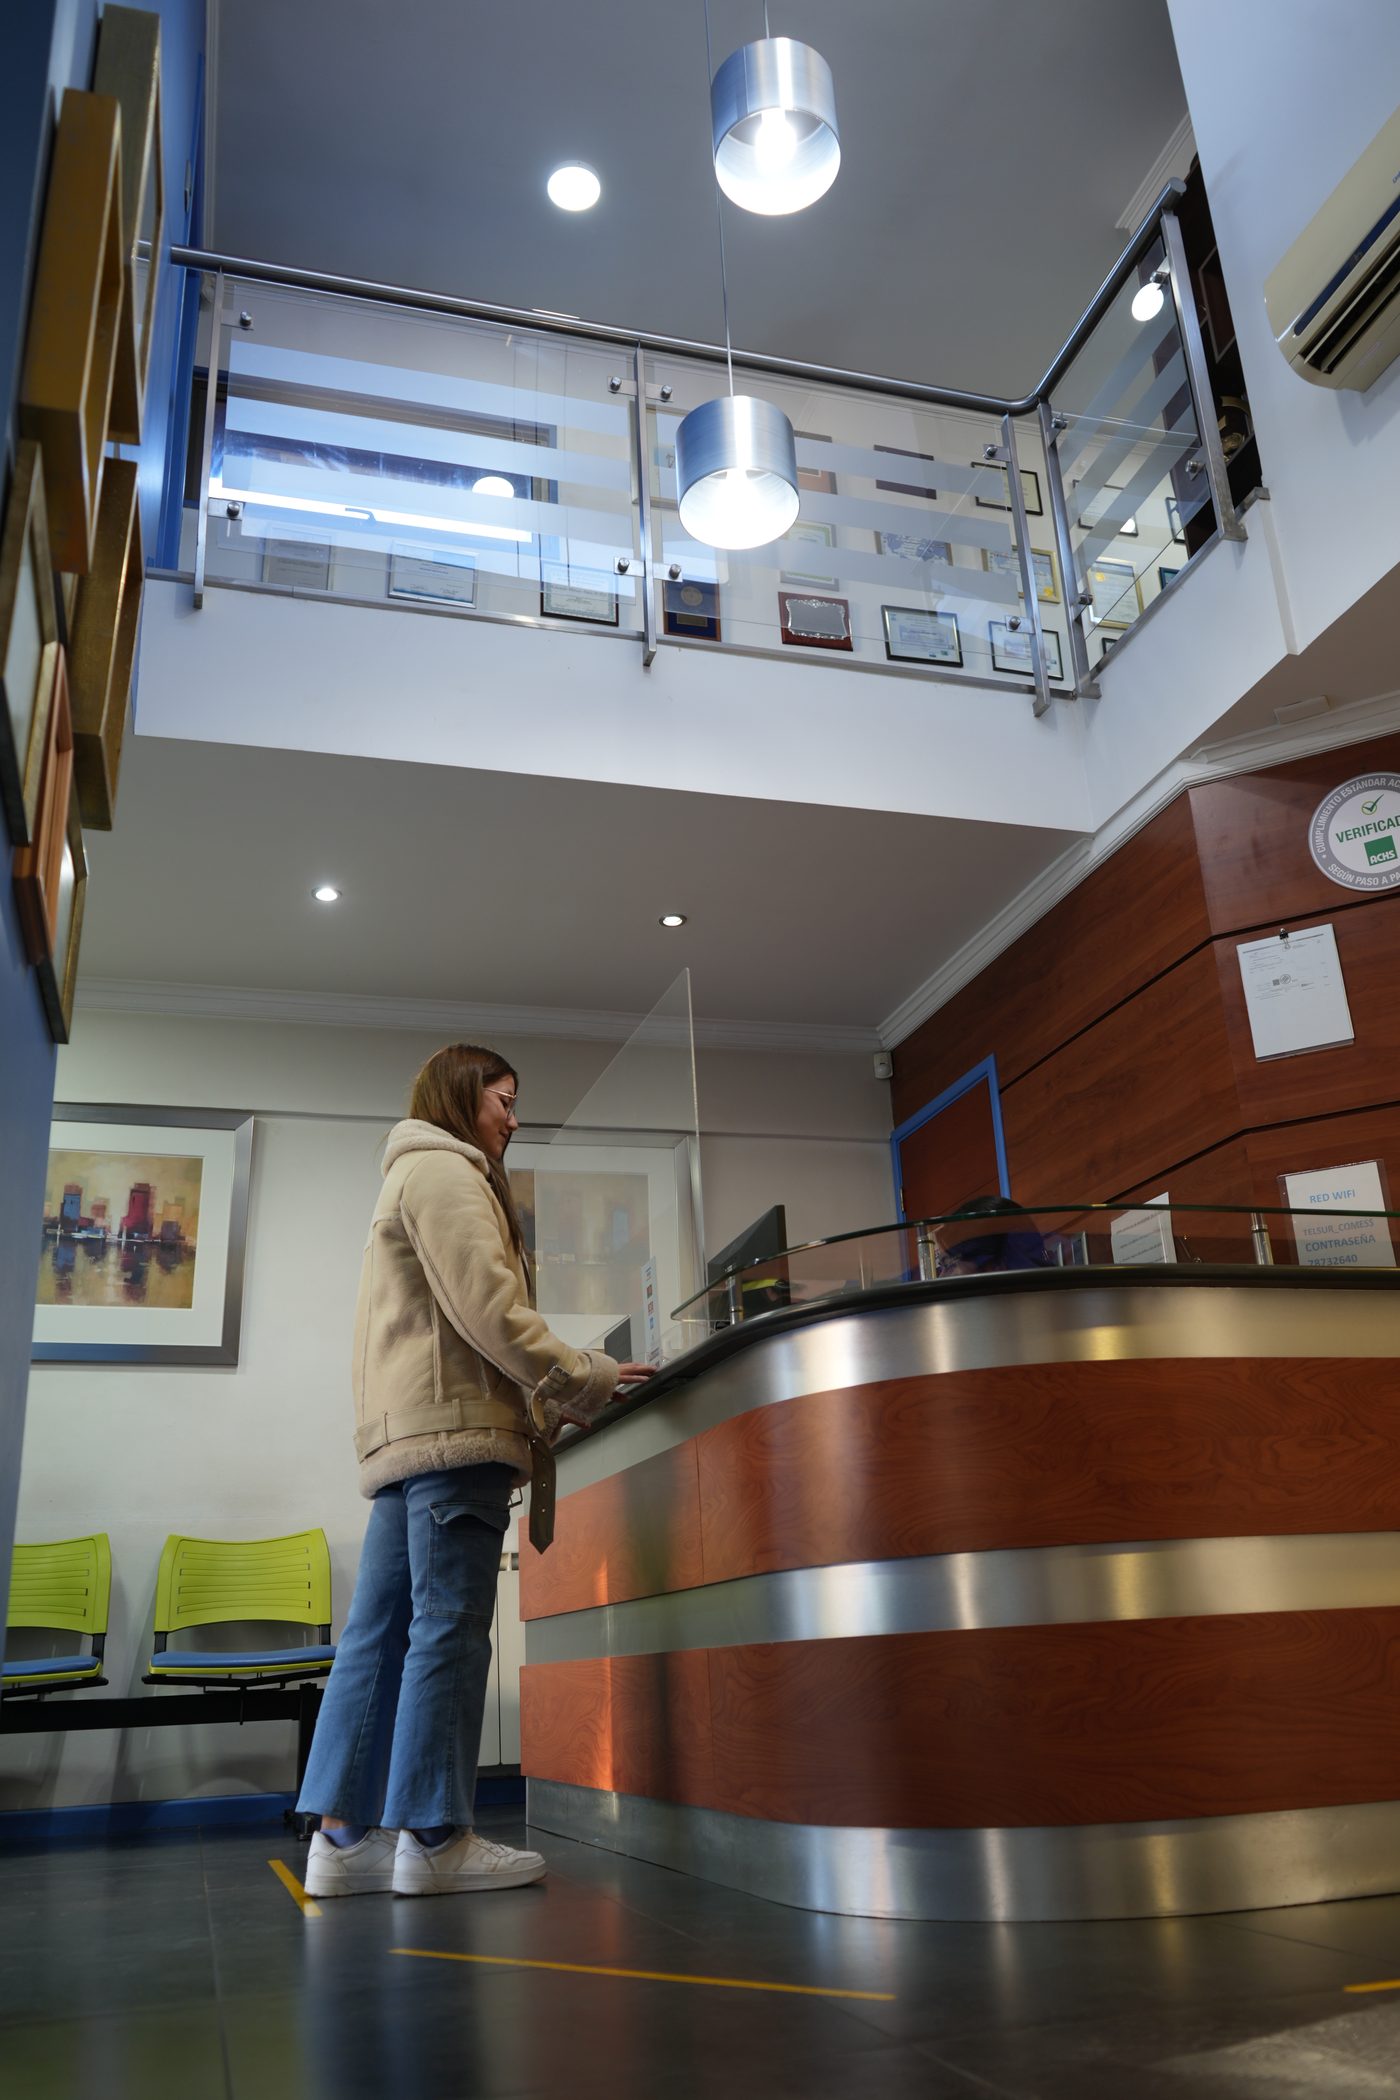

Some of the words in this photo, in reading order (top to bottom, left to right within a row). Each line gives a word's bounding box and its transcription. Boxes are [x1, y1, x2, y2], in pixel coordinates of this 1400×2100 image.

[1315, 794, 1342, 853] CUMPLIMIENTO
[1340, 777, 1387, 797] ESTÁNDAR
[1369, 850, 1396, 865] ACHS
[1328, 863, 1354, 883] SEGÚN
[1354, 876, 1379, 886] PASO
[1381, 876, 1389, 884] A
[1309, 1193, 1330, 1203] RED
[1332, 1189, 1356, 1200] WIFI
[1305, 1233, 1376, 1252] CONTRASEÑA
